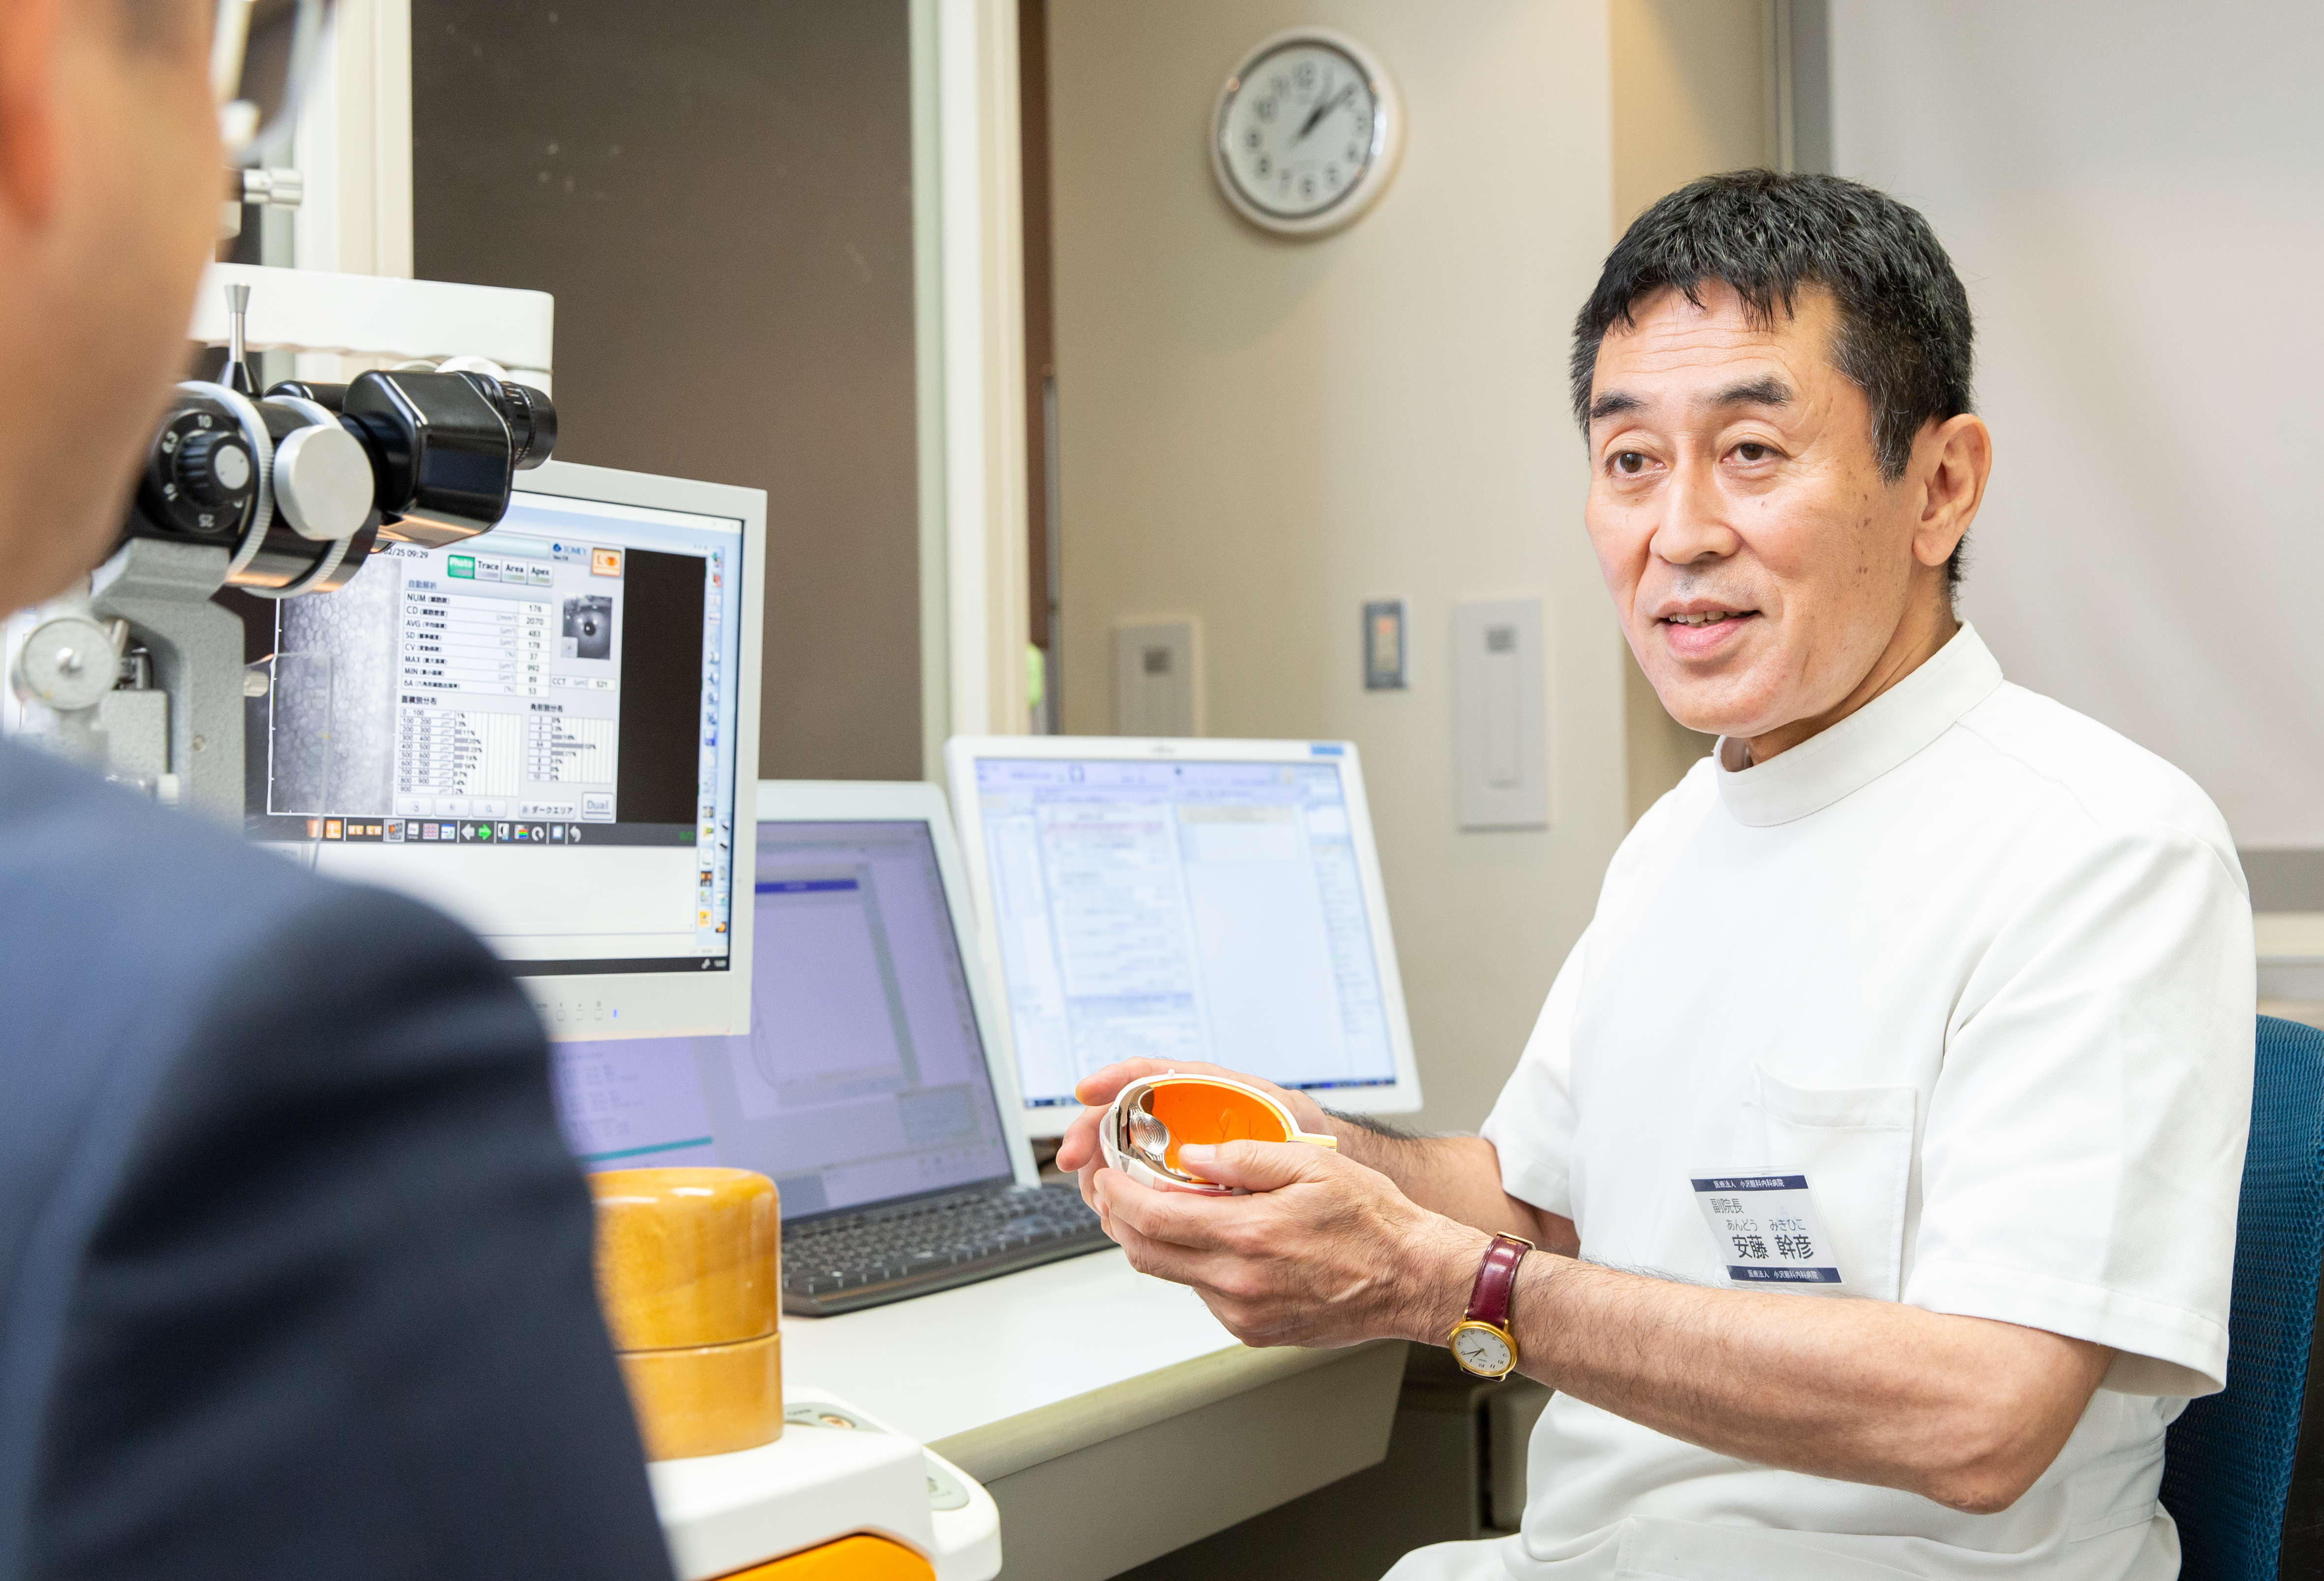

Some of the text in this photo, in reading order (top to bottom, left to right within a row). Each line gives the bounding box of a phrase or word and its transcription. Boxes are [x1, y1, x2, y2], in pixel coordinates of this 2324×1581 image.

[198, 414, 213, 429] 10
[407, 550, 428, 558] 09:29
[478, 561, 499, 570] Trace
[506, 564, 524, 572] Area
[407, 593, 426, 601] NUM
[587, 799, 608, 810] Dual
[1713, 1178, 1784, 1189] 医療法人 小沢眼科内科病院
[1710, 1198, 1744, 1213] 副院長
[1726, 1219, 1806, 1231] あんどう みきひこ
[1732, 1234, 1814, 1259] 安藤 幹彦
[1748, 1269, 1818, 1279] 医療法人 小沢眼科内科病院
